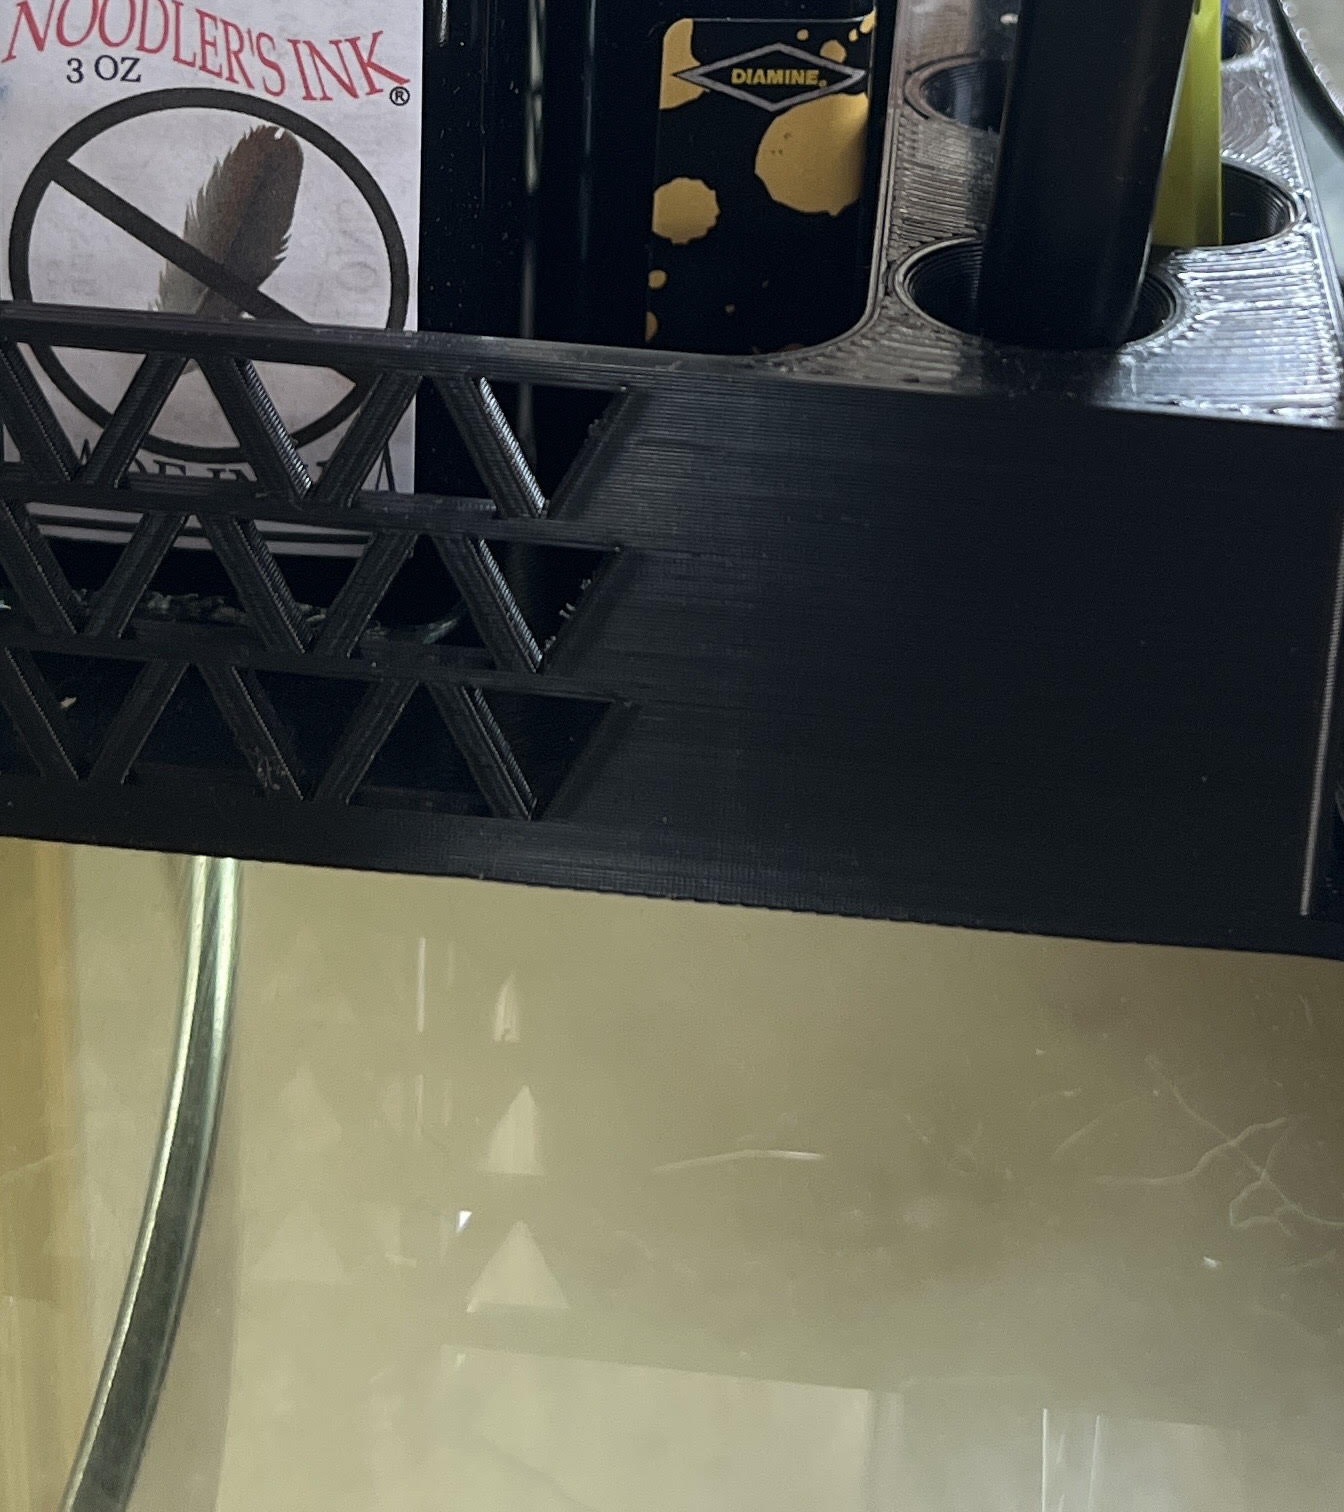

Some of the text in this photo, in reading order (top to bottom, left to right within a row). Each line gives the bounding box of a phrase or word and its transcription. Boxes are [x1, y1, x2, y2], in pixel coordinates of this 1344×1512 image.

[66, 54, 142, 84] 3 OZ
[731, 68, 820, 86] DIAMINE
